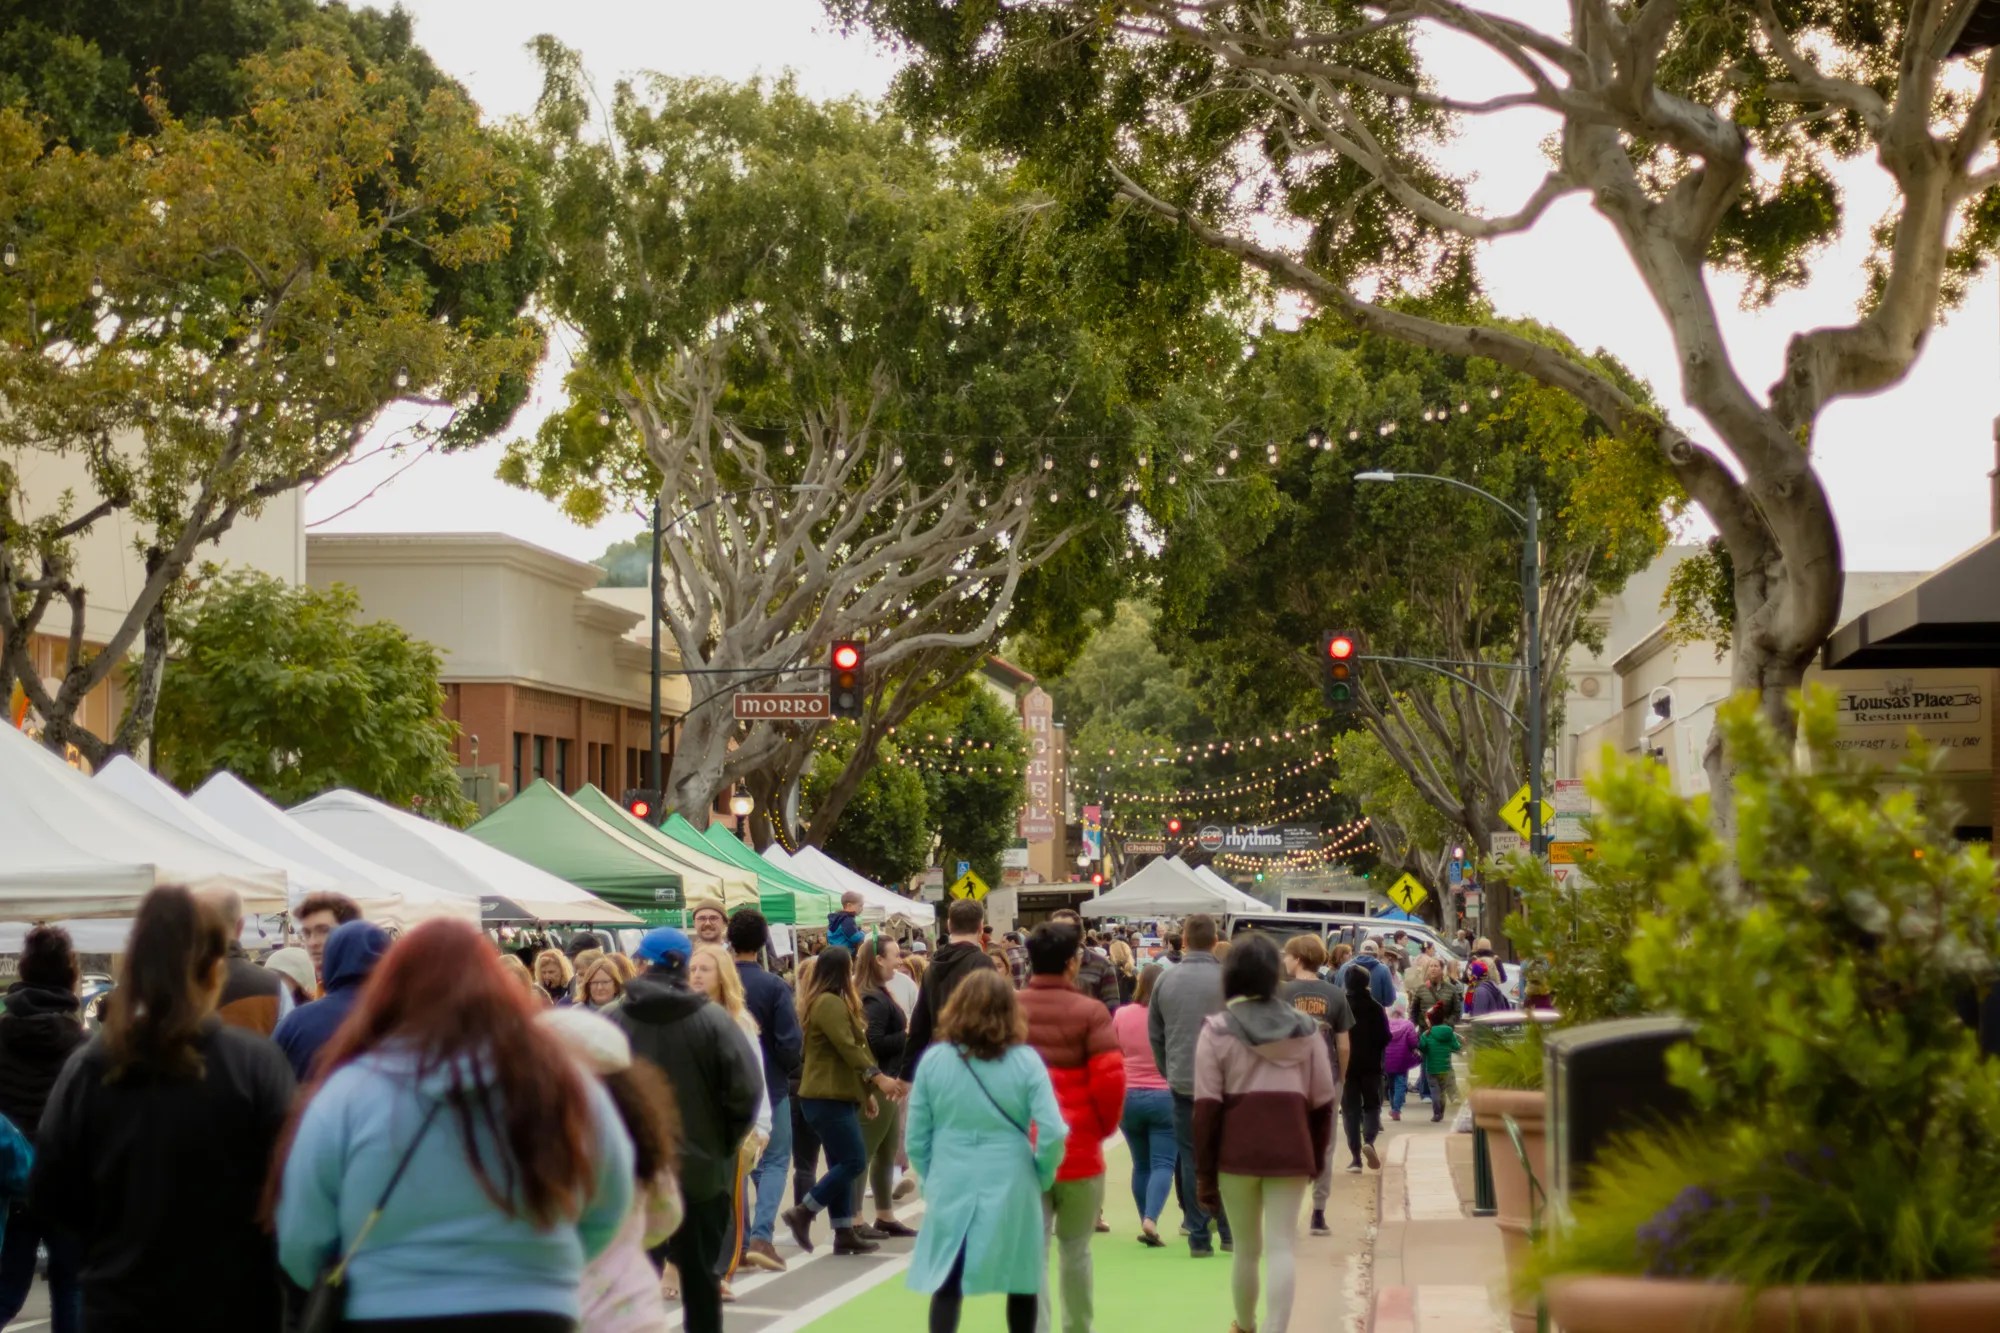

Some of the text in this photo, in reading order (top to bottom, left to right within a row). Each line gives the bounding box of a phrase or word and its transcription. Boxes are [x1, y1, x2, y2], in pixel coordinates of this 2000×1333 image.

[742, 699, 823, 713] MORRO
[1912, 693, 1954, 708] Place
[1855, 711, 1949, 721] Restaurant
[1962, 736, 1981, 747] DAY
[1030, 716, 1047, 820] HOTEL
[1225, 826, 1282, 850] rhythms
